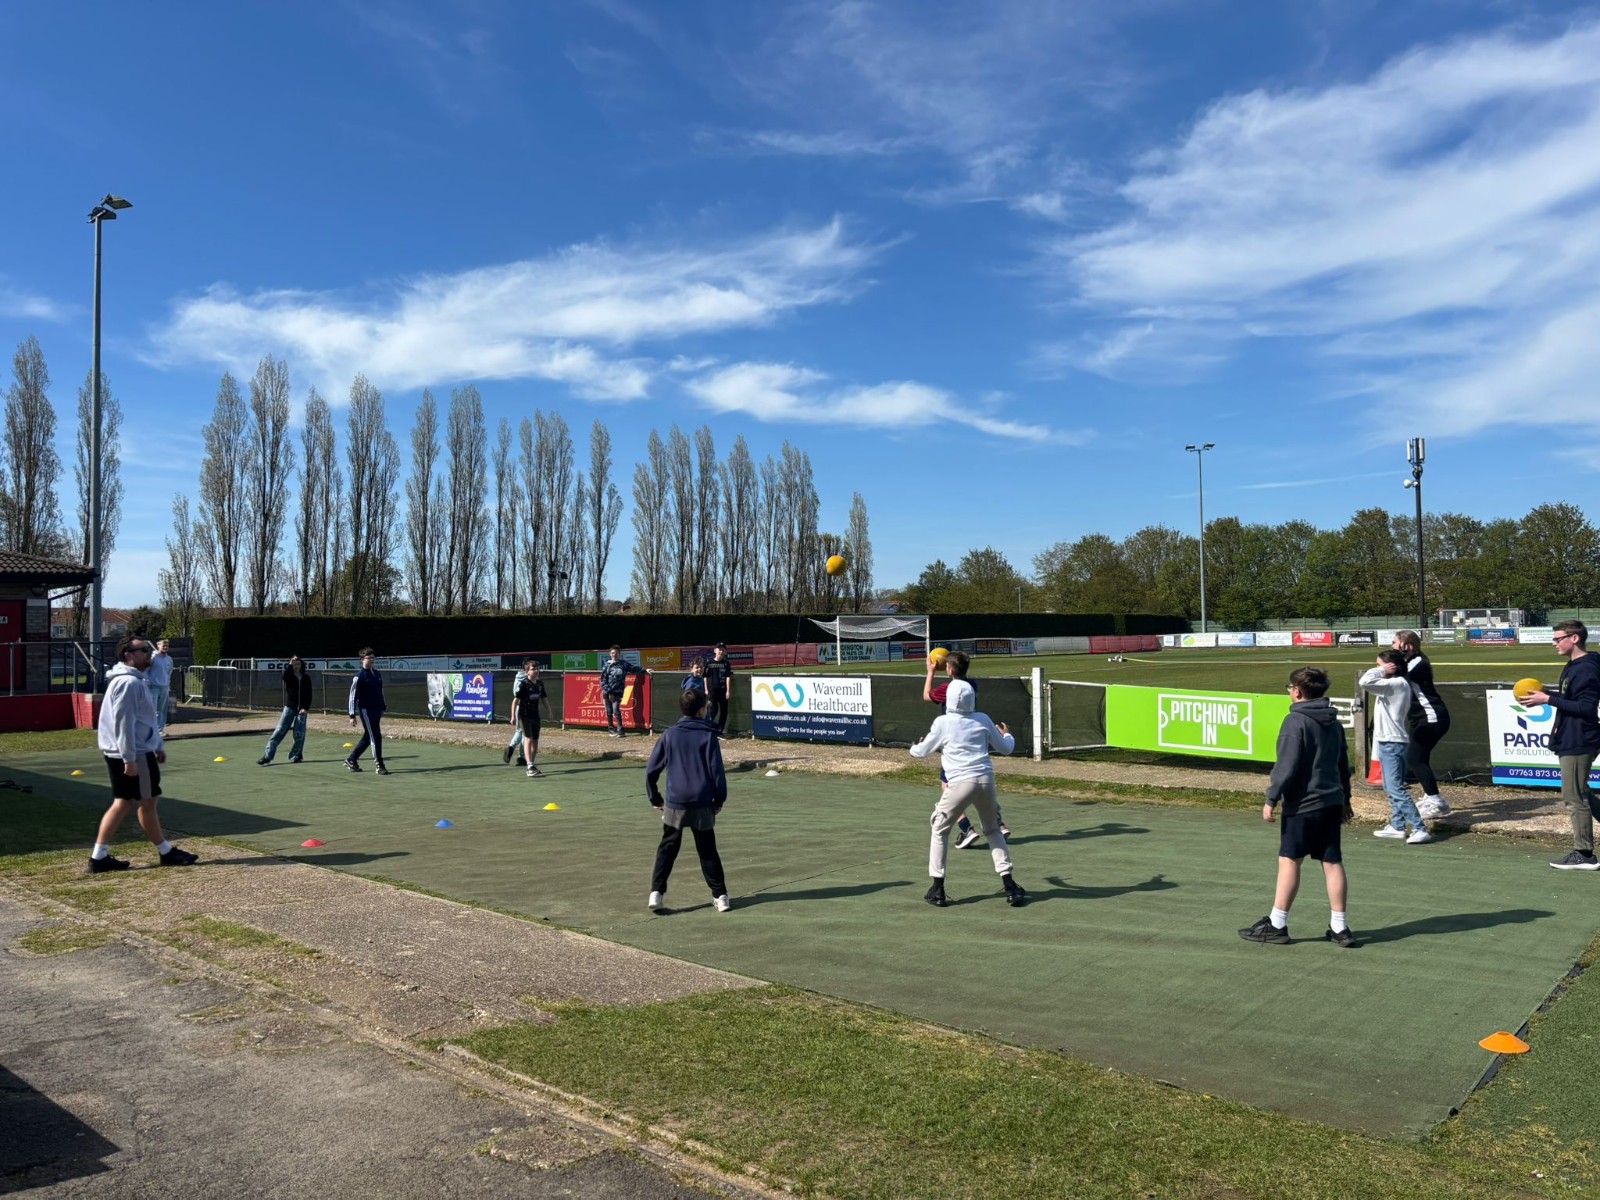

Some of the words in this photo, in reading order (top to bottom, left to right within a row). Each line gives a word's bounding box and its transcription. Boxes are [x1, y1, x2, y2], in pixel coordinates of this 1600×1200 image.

[813, 682, 863, 696] Wavemill
[808, 698, 869, 712] Healthcare
[1171, 701, 1238, 725] PITCHING
[1203, 723, 1217, 745] IN
[1516, 748, 1555, 756] SOLUTIO
[1509, 769, 1534, 777] 07763
[1535, 770, 1550, 778] 873
[1552, 770, 1562, 778] 04
